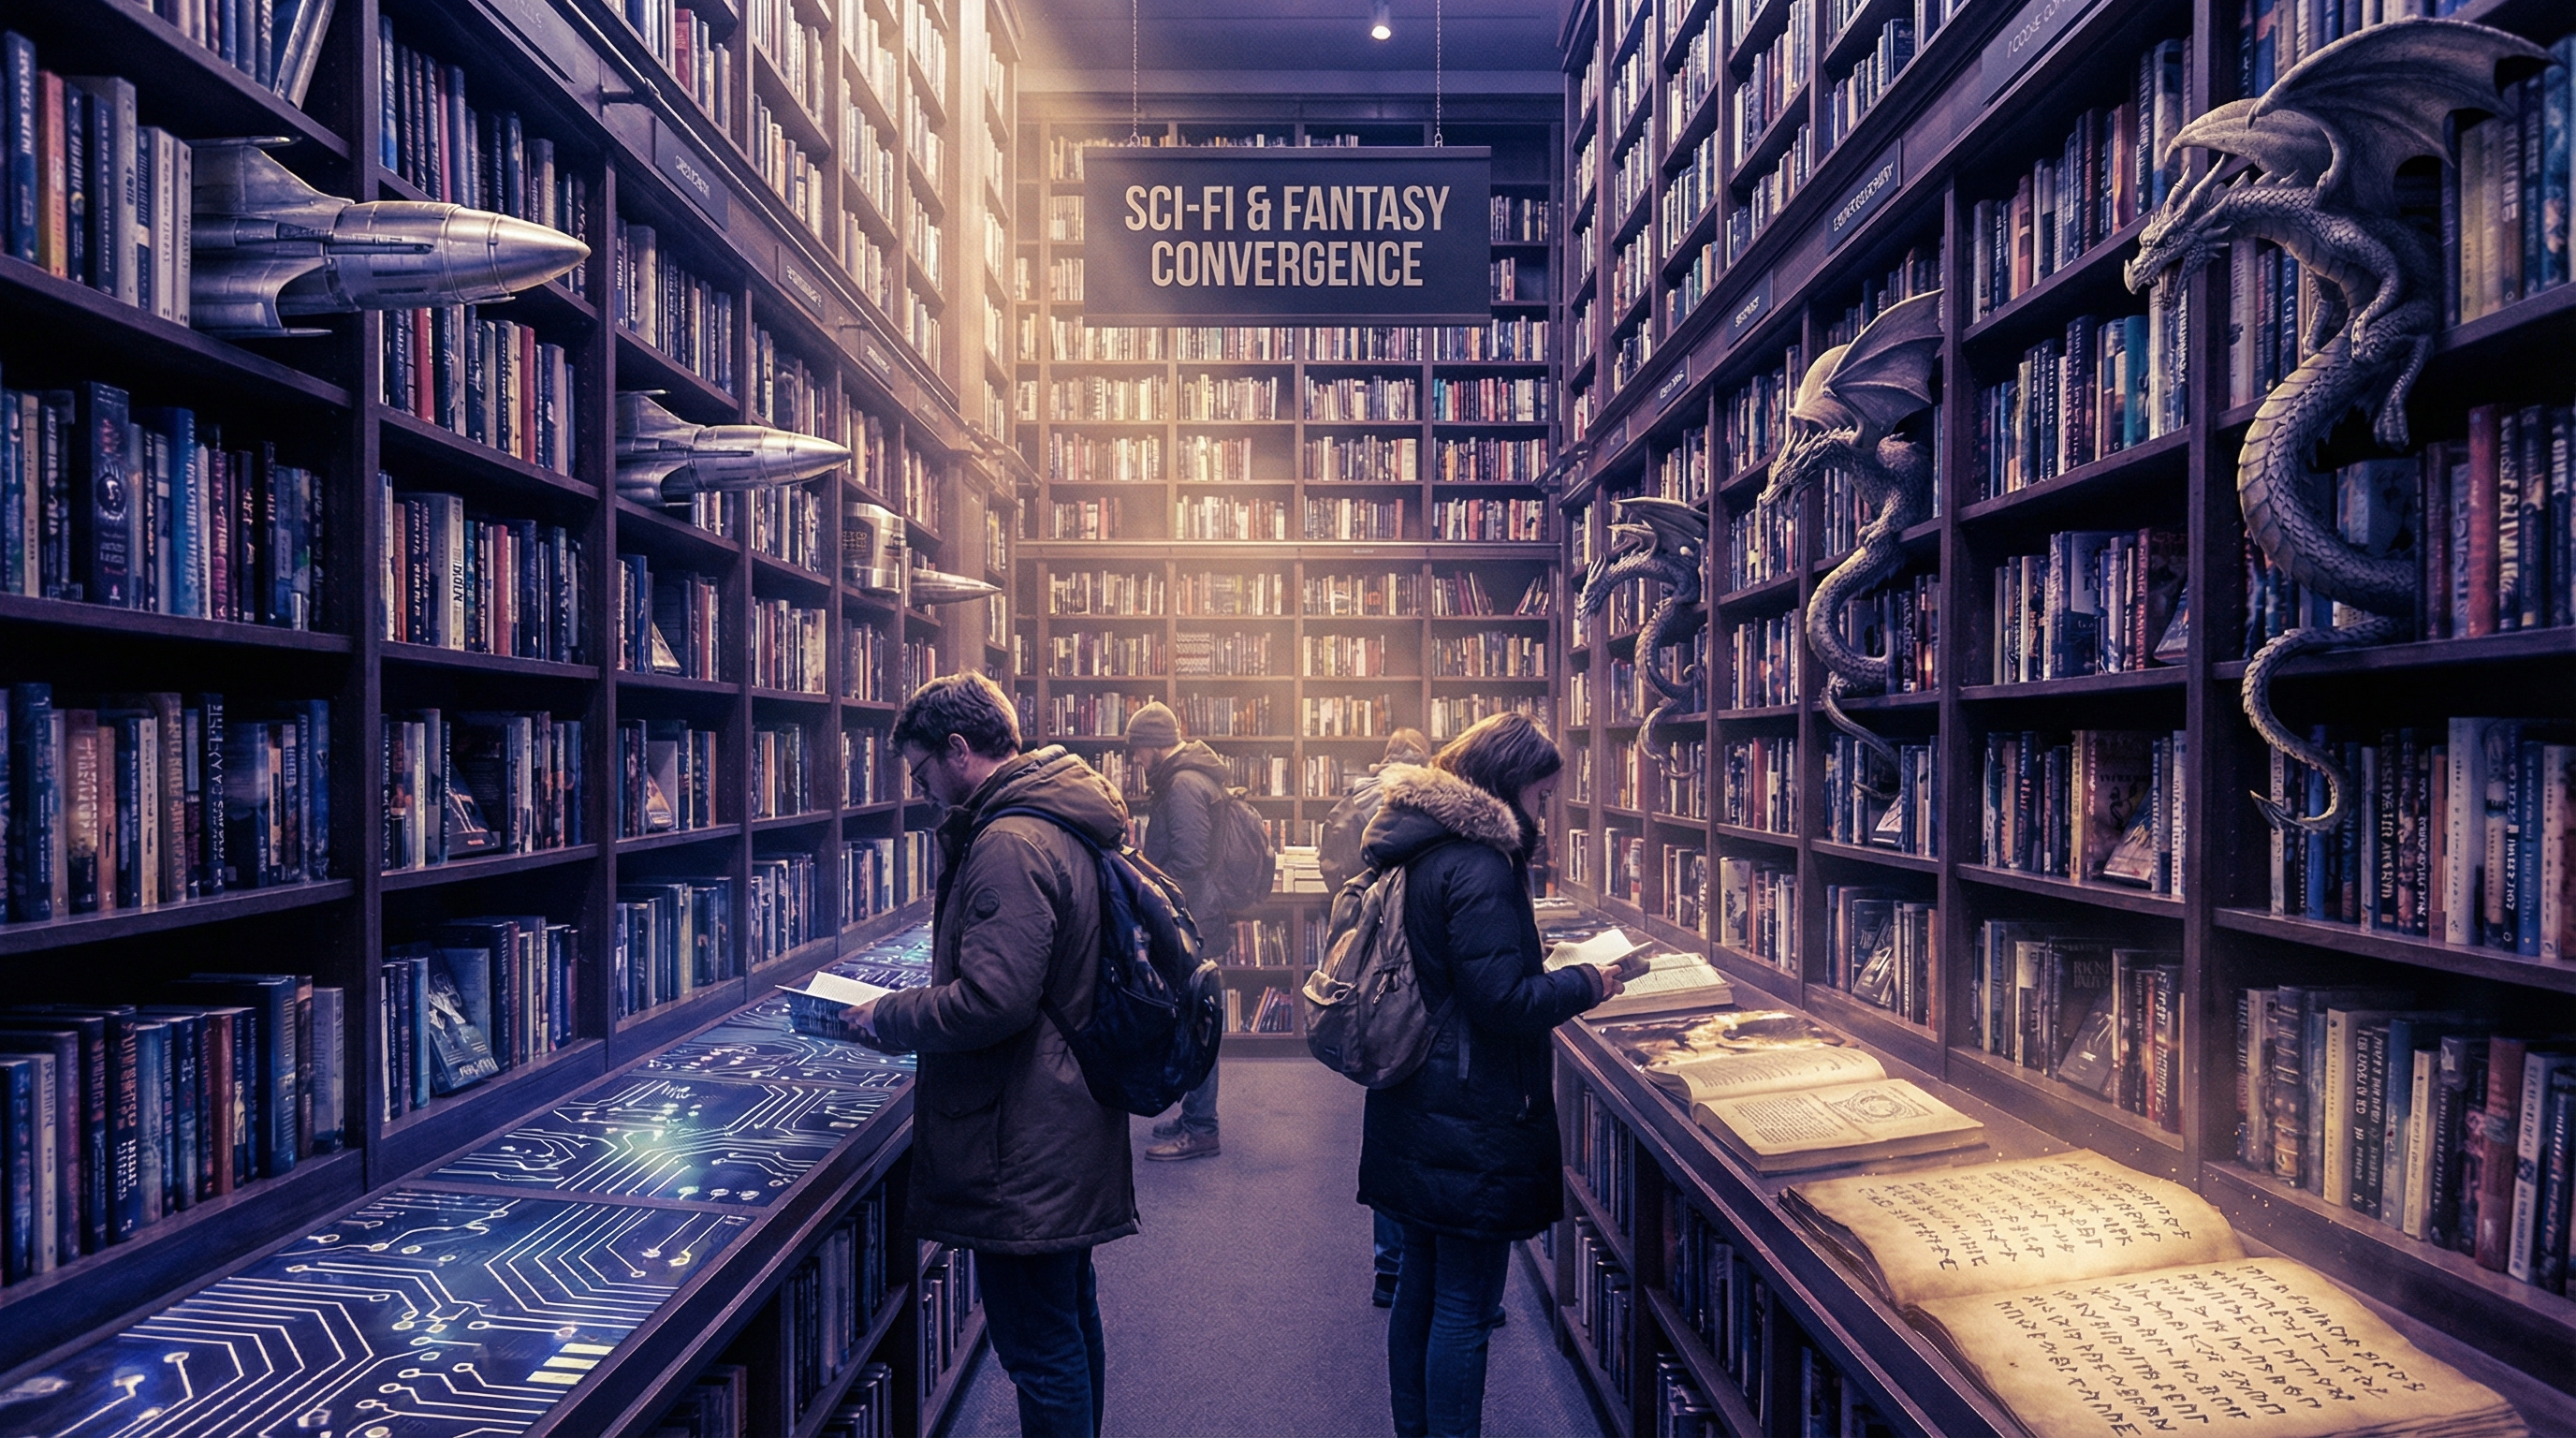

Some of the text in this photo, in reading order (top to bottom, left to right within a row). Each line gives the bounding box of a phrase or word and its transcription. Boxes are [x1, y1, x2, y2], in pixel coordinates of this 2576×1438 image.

[1125, 185, 1450, 231] SCI-FI & FANTASY
[1151, 241, 1423, 286] CONVERGENCE
